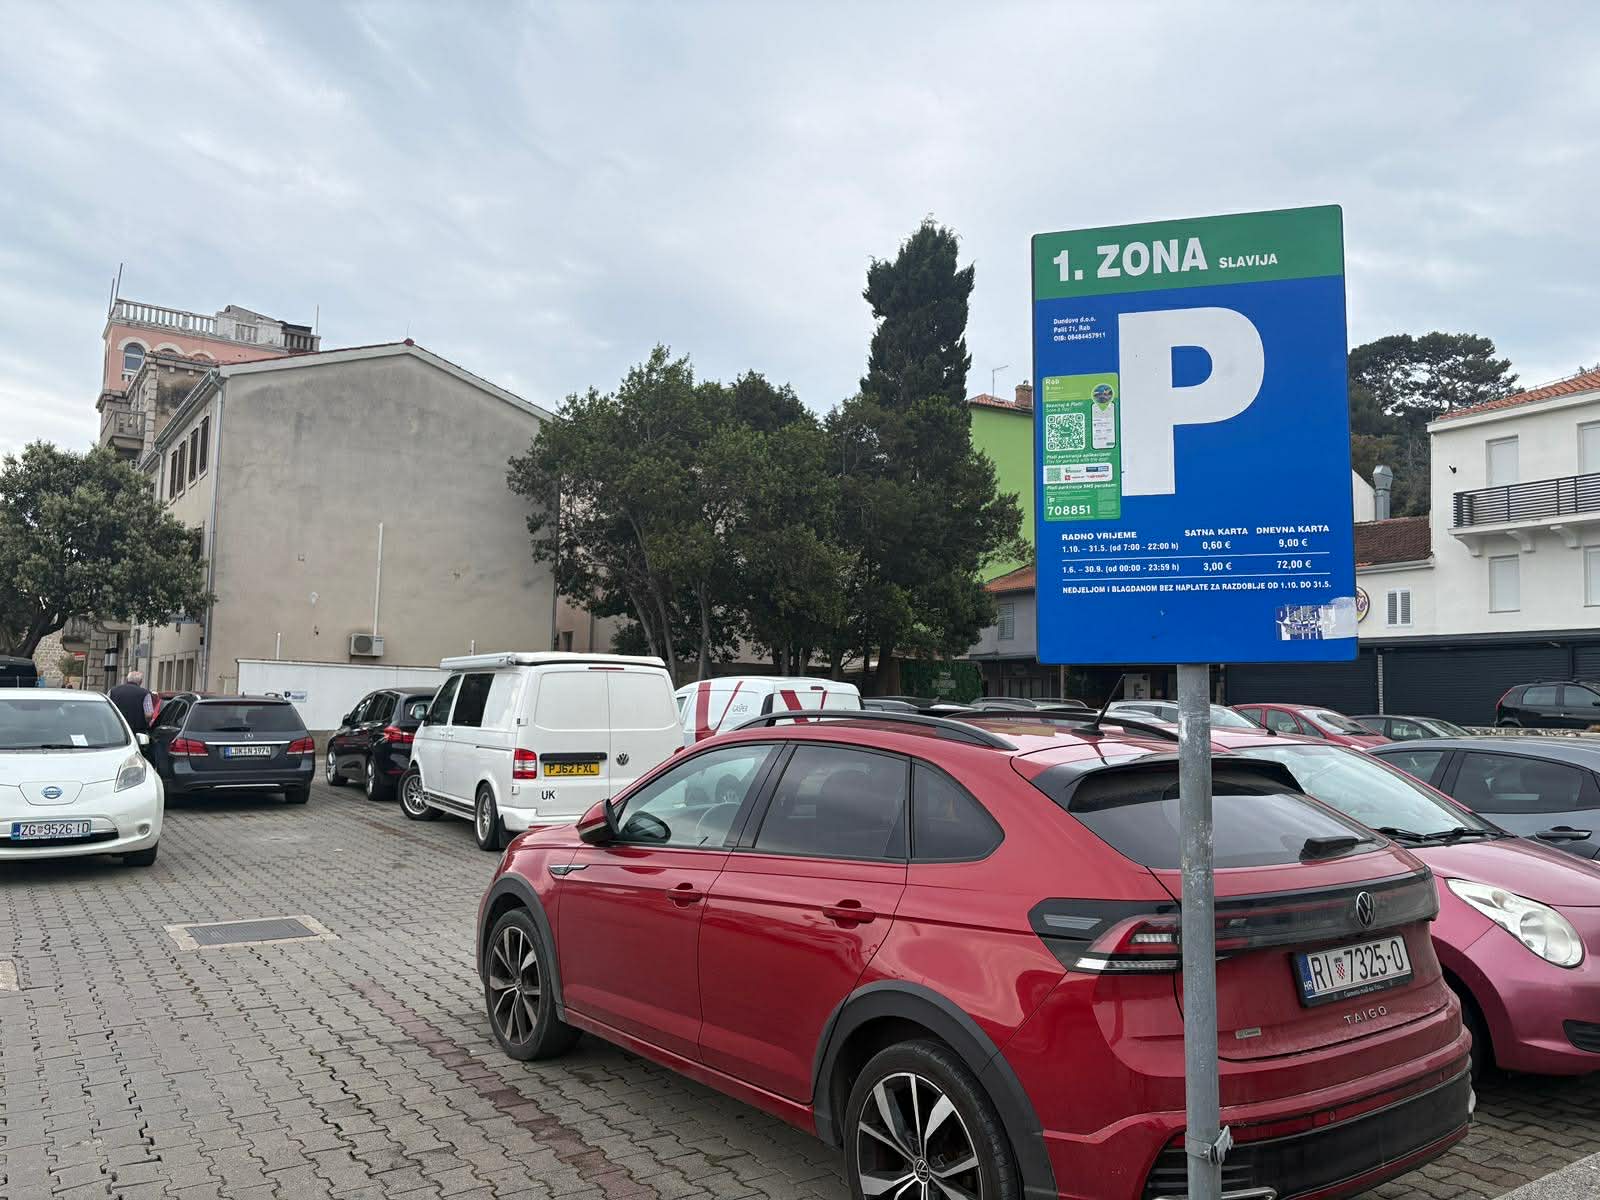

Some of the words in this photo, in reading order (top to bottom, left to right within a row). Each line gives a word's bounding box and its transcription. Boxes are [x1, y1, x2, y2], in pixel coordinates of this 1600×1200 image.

[1053, 250, 1083, 282] 1.
[1096, 237, 1208, 279] ZONA
[1219, 252, 1278, 268] SLAVIJA
[1118, 307, 1266, 497] P
[1048, 505, 1091, 516] 708851
[1062, 532, 1094, 540] RADNO
[1110, 544, 1121, 552] (od
[1171, 542, 1179, 551] h)
[1202, 541, 1222, 550] 0,60
[1279, 539, 1298, 548] 9,00
[1105, 565, 1117, 573] (od
[1172, 563, 1180, 571] h)
[1203, 562, 1223, 572] 3,00
[1277, 560, 1303, 569] 72,00
[1112, 584, 1157, 592] BLAGDANOM
[549, 764, 574, 773] PJ62
[577, 763, 594, 773] FXL
[541, 790, 555, 800] UK
[21, 825, 36, 836] ZG
[1310, 955, 1334, 990] RI
[1303, 981, 1314, 991] HR
[1344, 1006, 1386, 1024] TAIGO
